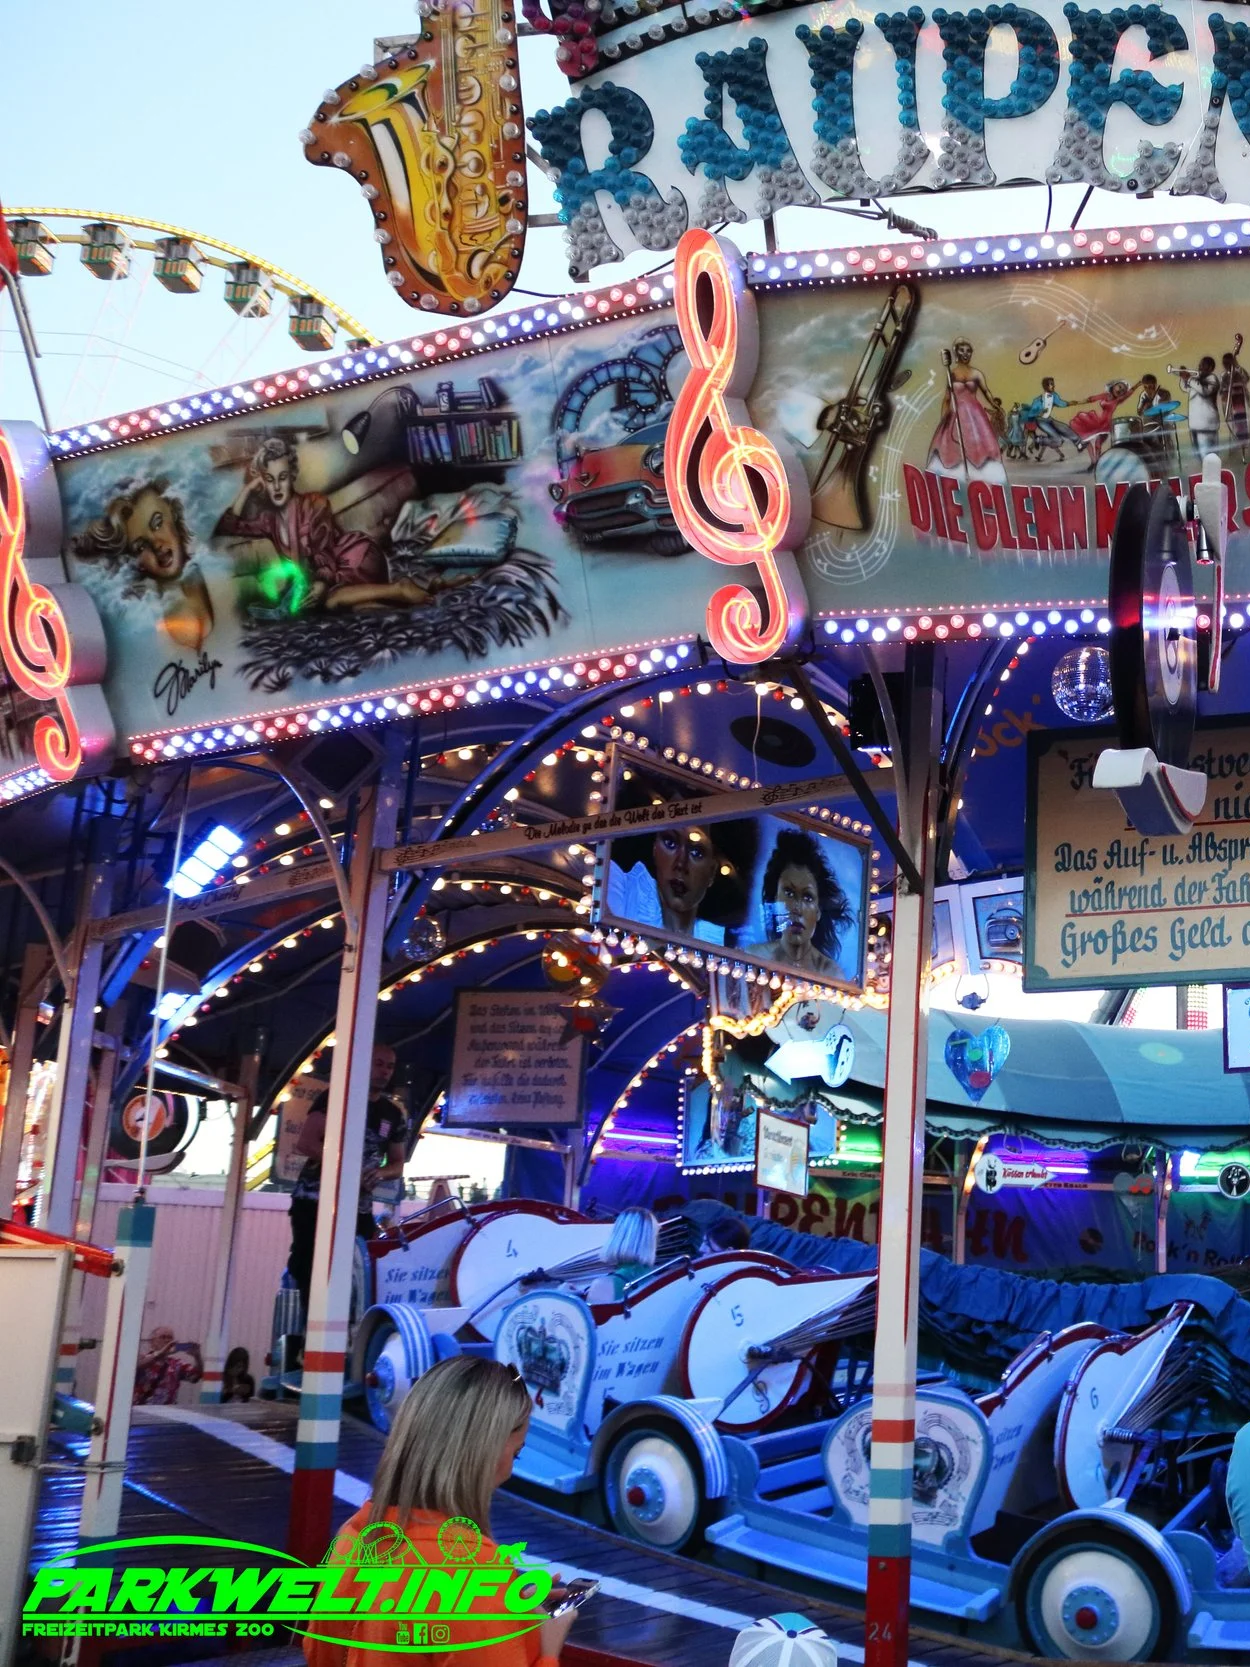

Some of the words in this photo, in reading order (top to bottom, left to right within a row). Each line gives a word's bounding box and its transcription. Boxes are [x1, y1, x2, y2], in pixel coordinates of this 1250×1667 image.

[903, 462, 968, 543] DIE
[967, 480, 1088, 552] GLENN
[624, 808, 650, 824] Welt
[1054, 842, 1098, 873] Das
[1103, 838, 1156, 877] Auf-
[1161, 843, 1185, 867] u.
[1069, 875, 1168, 914] während
[1173, 875, 1210, 908] der
[1060, 920, 1159, 969] Großes
[1167, 915, 1232, 962] Geld
[384, 1267, 408, 1283] Sie
[730, 1304, 745, 1328] 5
[597, 1340, 620, 1357] Sie
[622, 1334, 666, 1353] sitzen
[615, 1358, 661, 1380] Wagen
